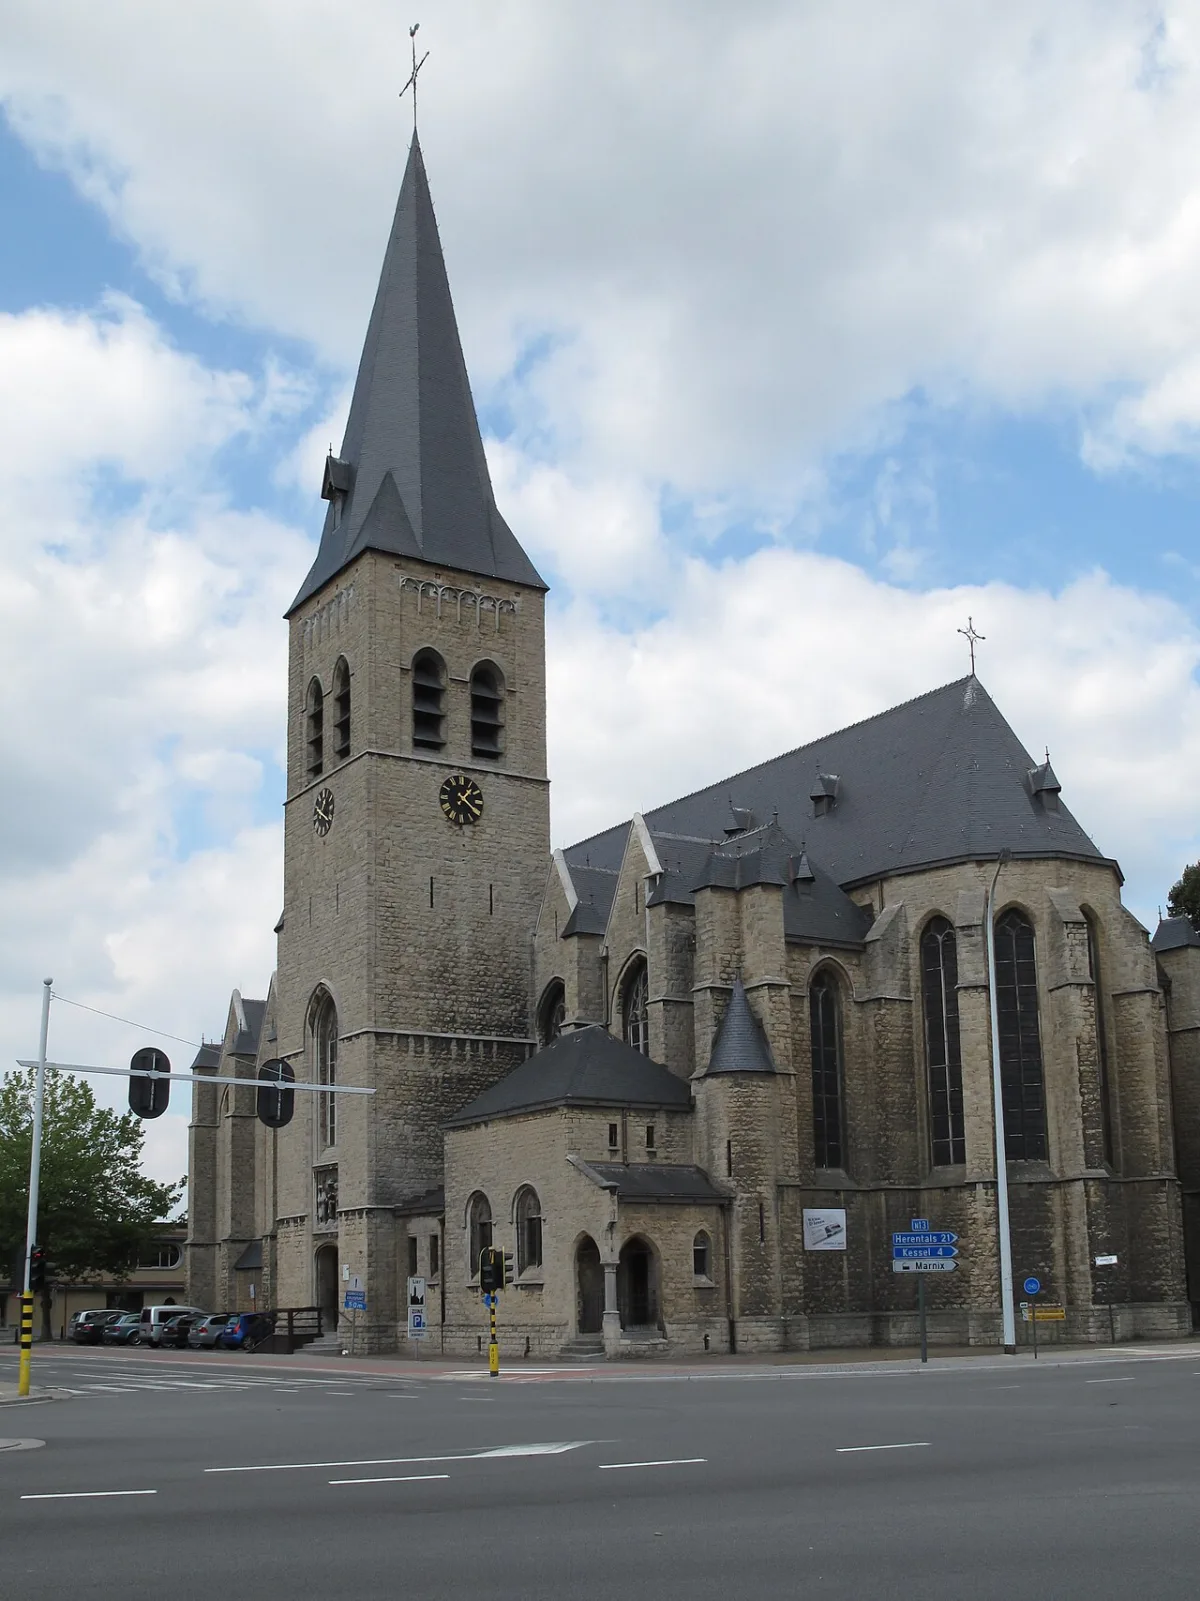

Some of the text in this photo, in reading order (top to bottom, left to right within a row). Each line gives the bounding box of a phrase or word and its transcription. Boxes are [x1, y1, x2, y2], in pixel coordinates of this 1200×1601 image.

[914, 1221, 927, 1229] N13
[895, 1234, 950, 1243] Herentals 21
[902, 1248, 943, 1257] Kessel 4
[915, 1262, 945, 1270] Marnix
